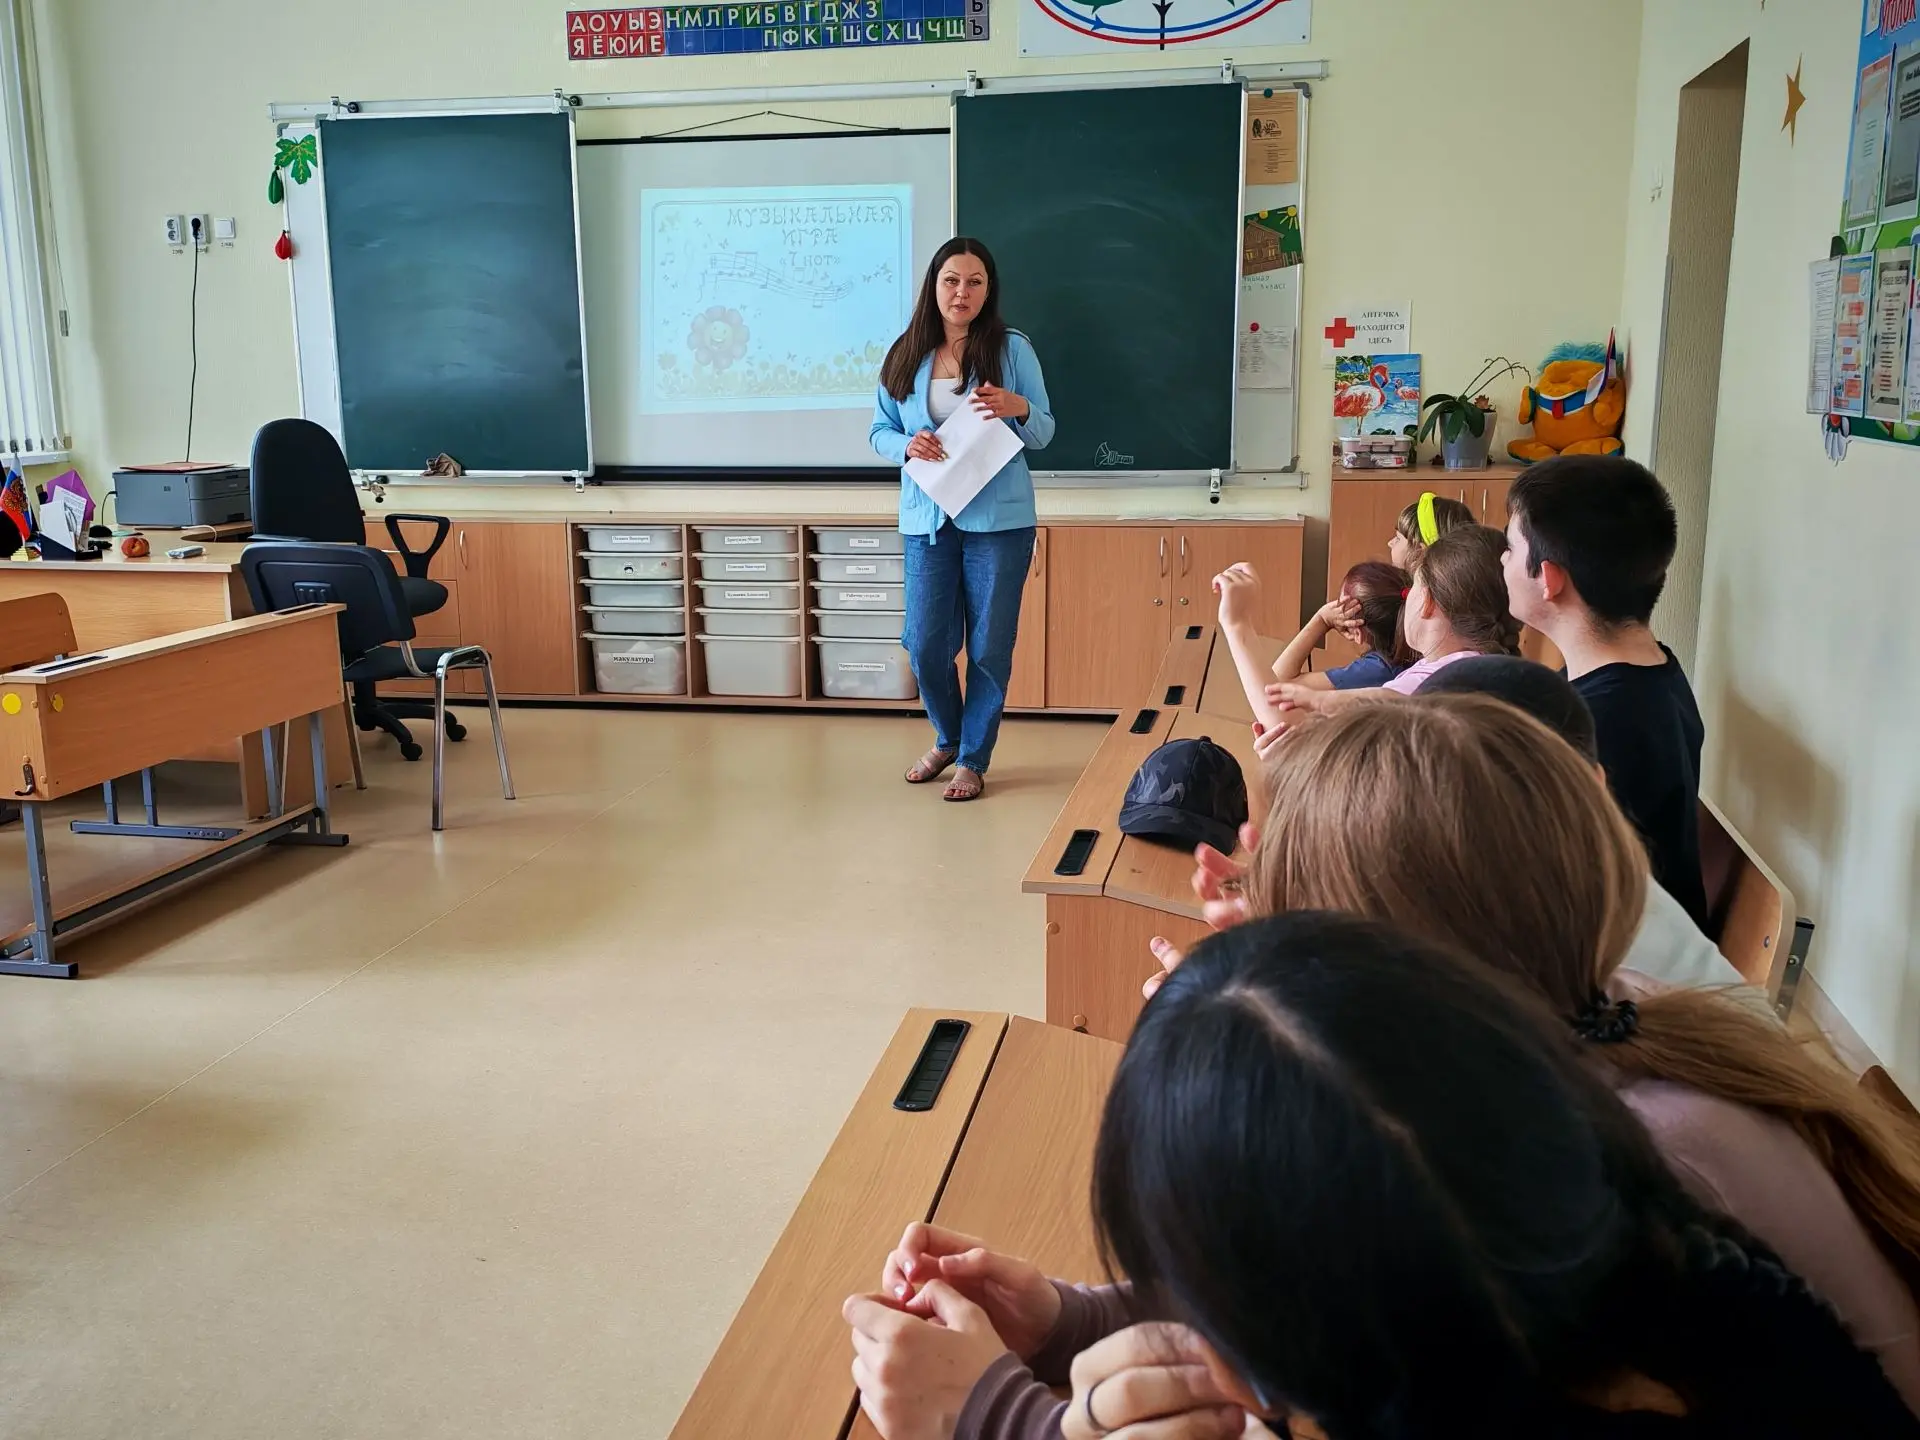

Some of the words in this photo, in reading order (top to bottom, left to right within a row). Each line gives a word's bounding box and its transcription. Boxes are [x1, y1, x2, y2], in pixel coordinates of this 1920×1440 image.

[727, 205, 894, 228] МУЗЫКАЛЬНАЯ
[782, 228, 838, 246] ИГРА
[1361, 311, 1400, 319] АПТЕЧКА
[1355, 323, 1405, 332] НАХОДИТСЯ
[613, 656, 654, 664] макулатура
